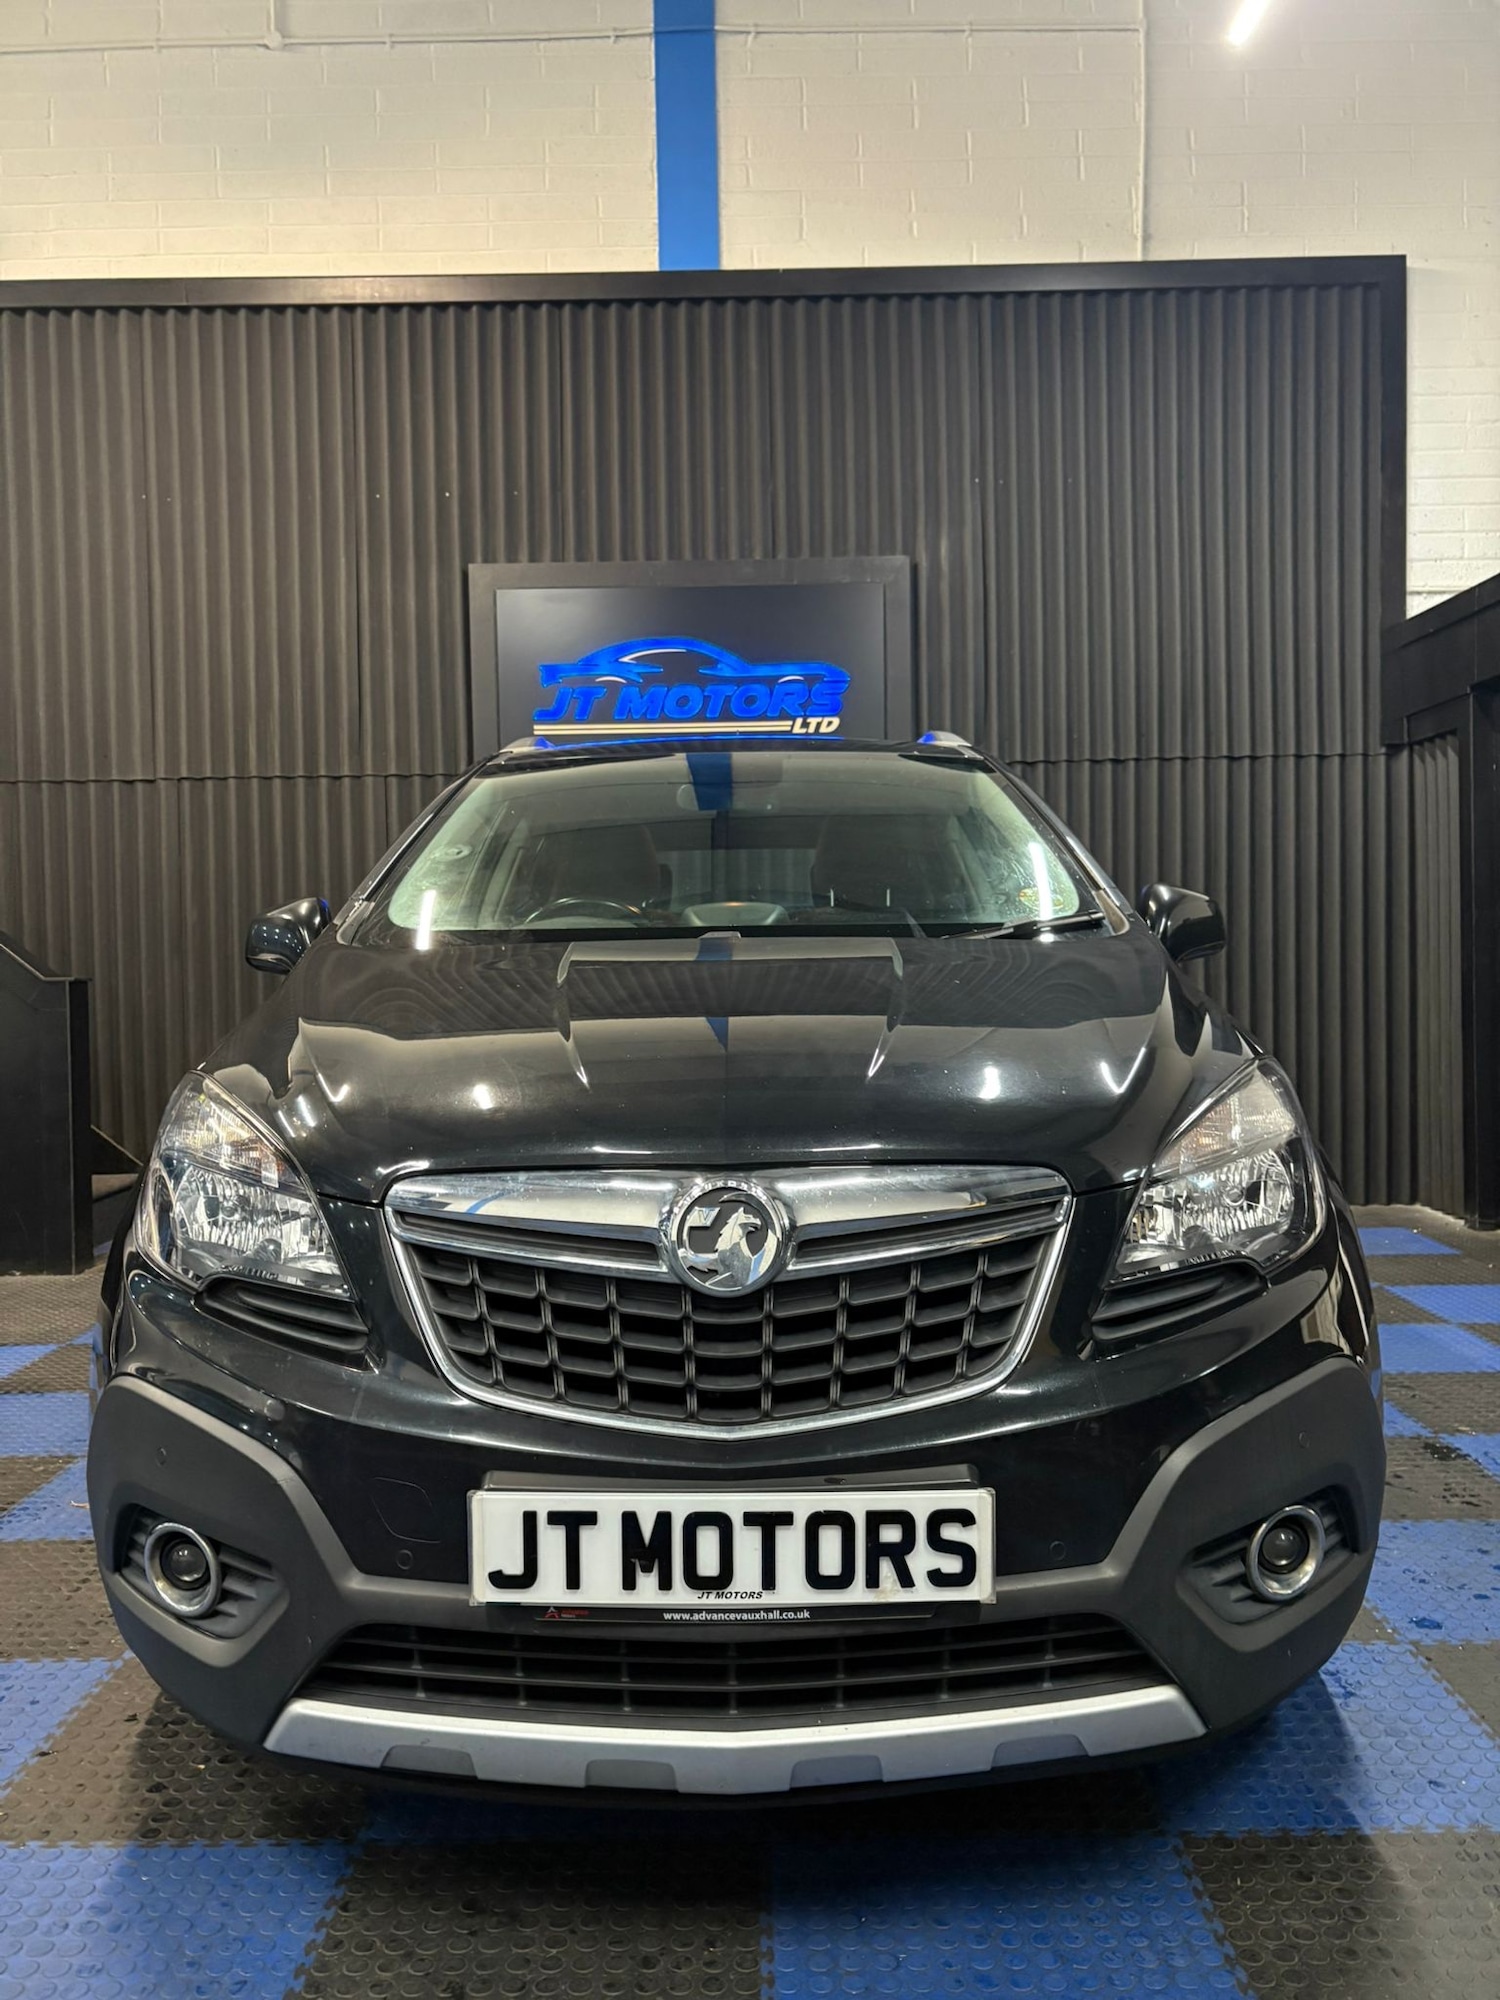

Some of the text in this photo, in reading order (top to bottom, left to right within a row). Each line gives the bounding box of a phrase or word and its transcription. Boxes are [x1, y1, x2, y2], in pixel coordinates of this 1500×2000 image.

[532, 678, 851, 721] JT MOTORS
[791, 716, 841, 735] LTD
[488, 1508, 976, 1591] JT MOTORS
[697, 1591, 763, 1600] JT MOTORS
[663, 1609, 811, 1622] www.advancevauxhall.co.uk
